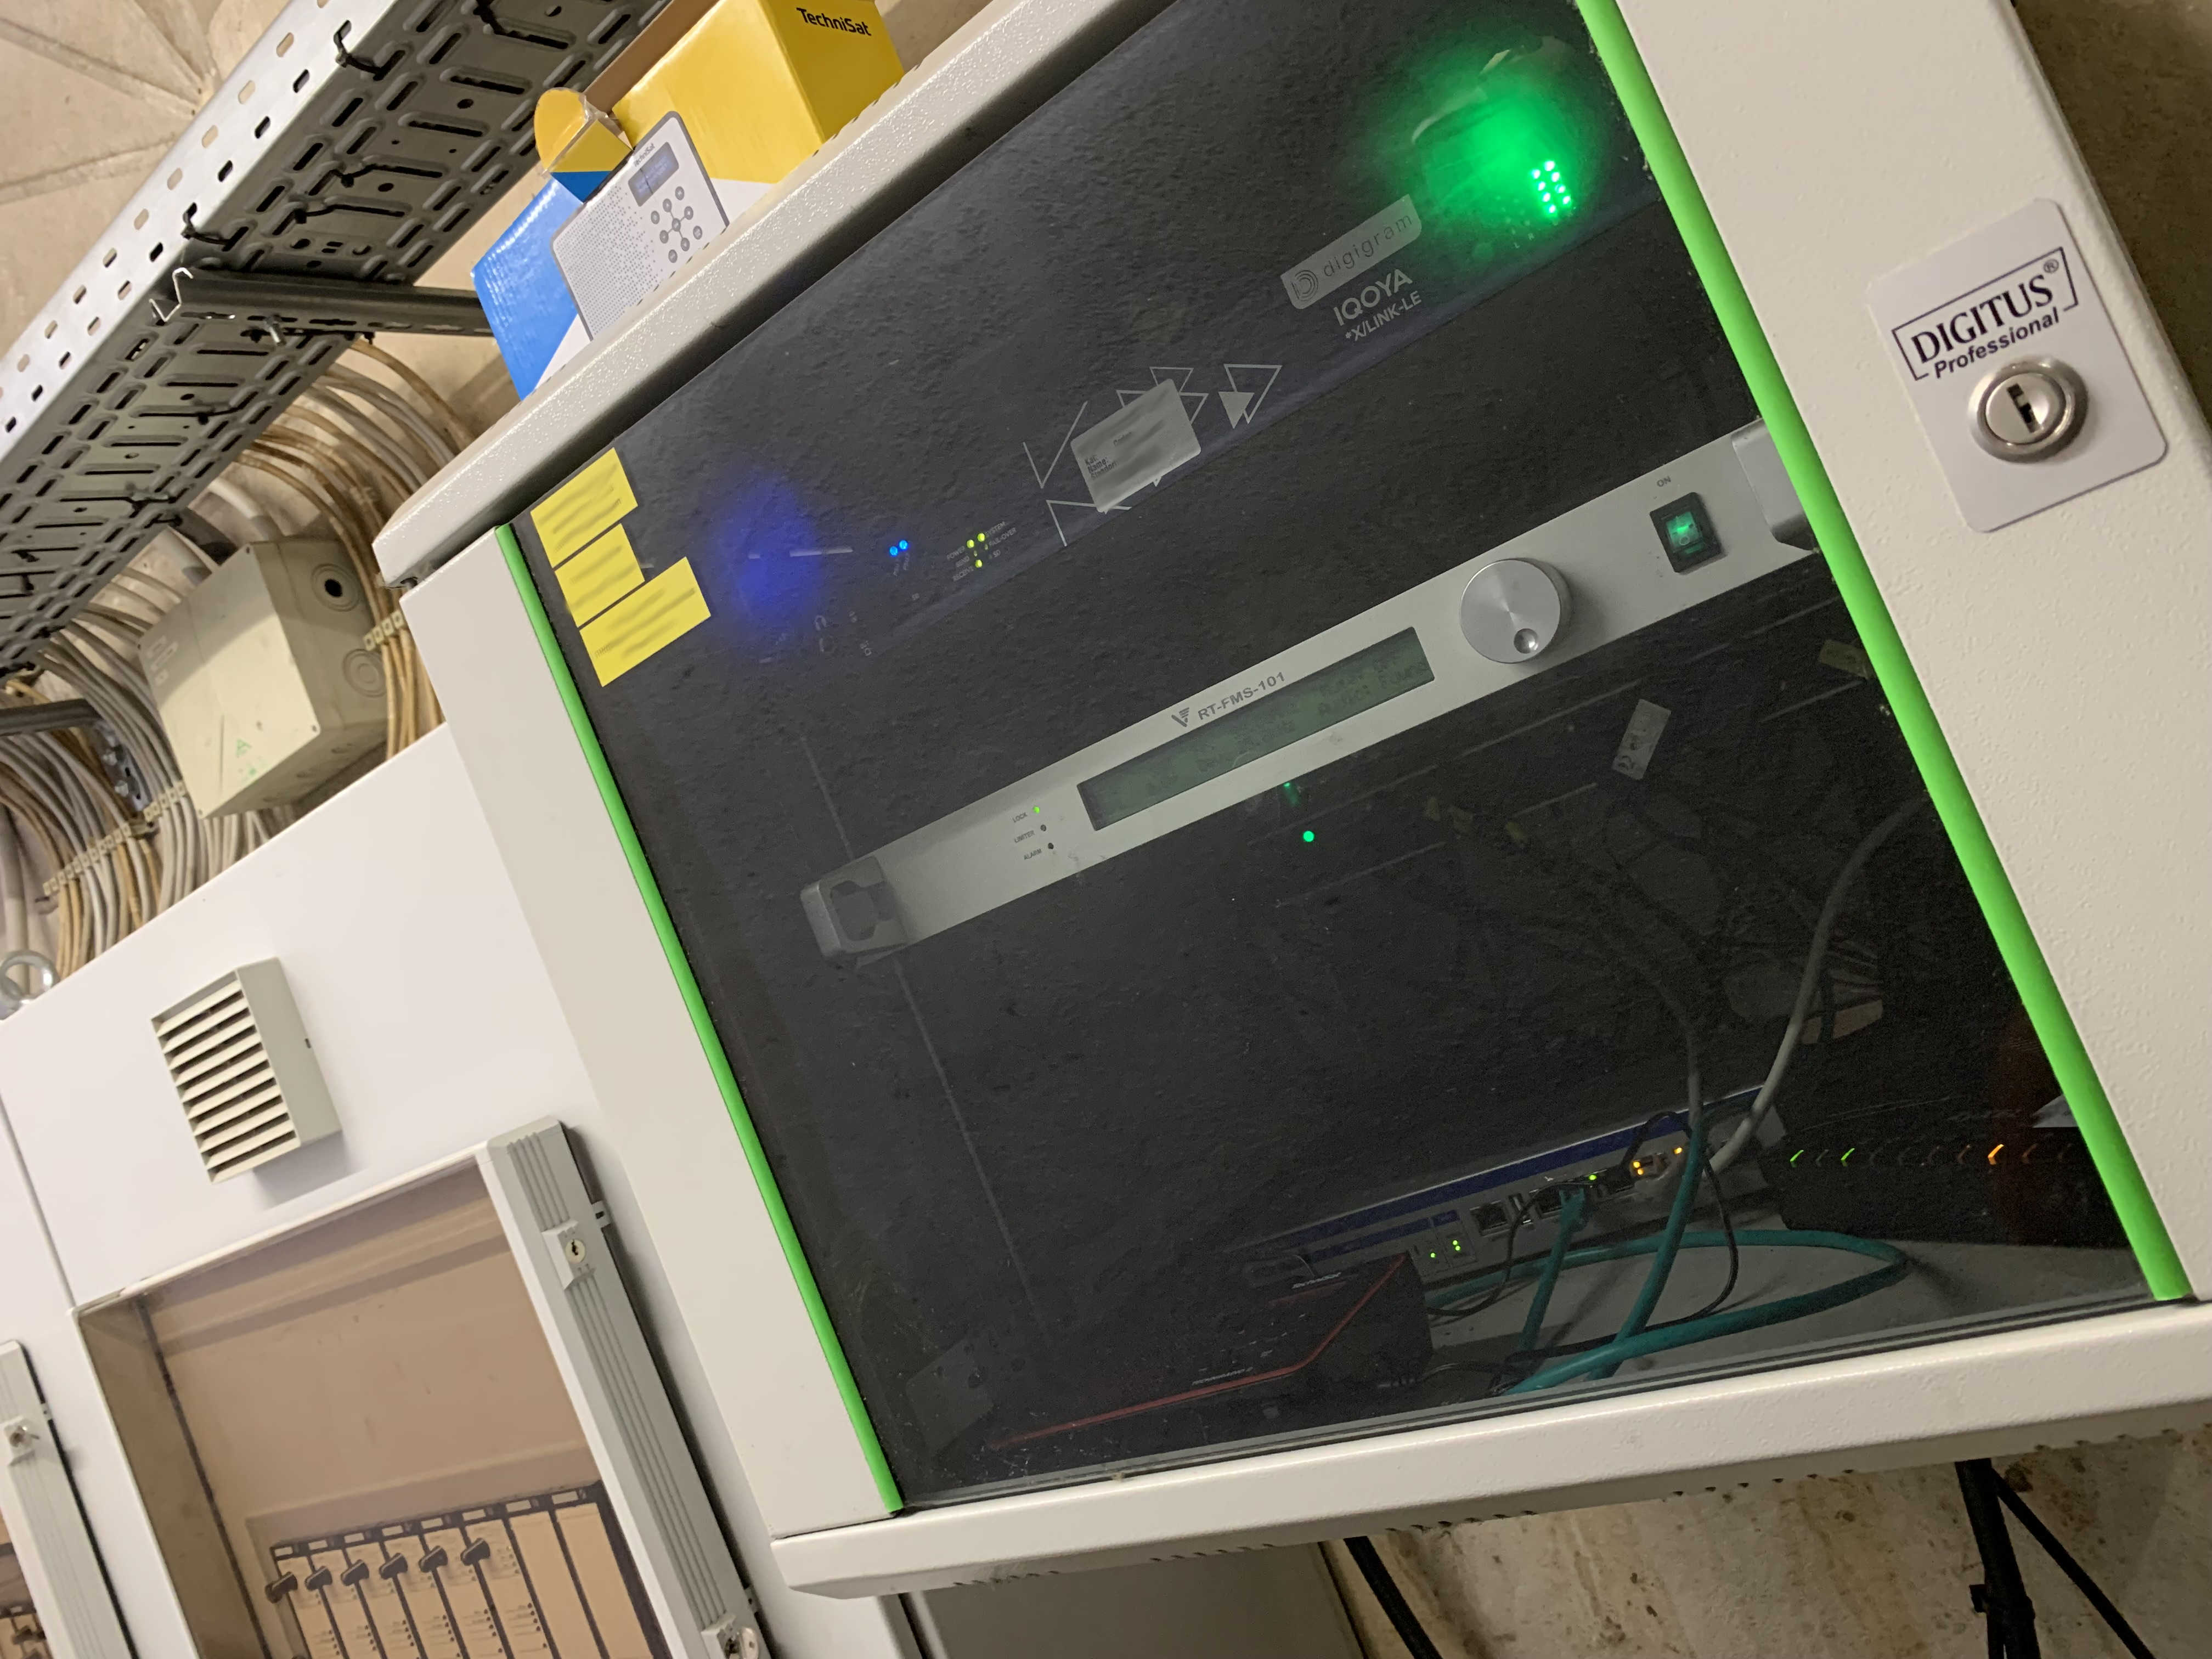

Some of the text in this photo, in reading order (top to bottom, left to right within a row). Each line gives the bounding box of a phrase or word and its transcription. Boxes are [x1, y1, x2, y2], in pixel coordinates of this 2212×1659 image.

[796, 7, 872, 36] TechniSat
[1323, 215, 1413, 277] digigram
[1333, 269, 1413, 326] IQOYA
[1934, 306, 2059, 379] Professional
[1656, 476, 1672, 487] ON
[1198, 672, 1285, 720] RT-FMS-101
[1012, 812, 1028, 823] LOCK
[1023, 848, 1042, 860] ALARM
